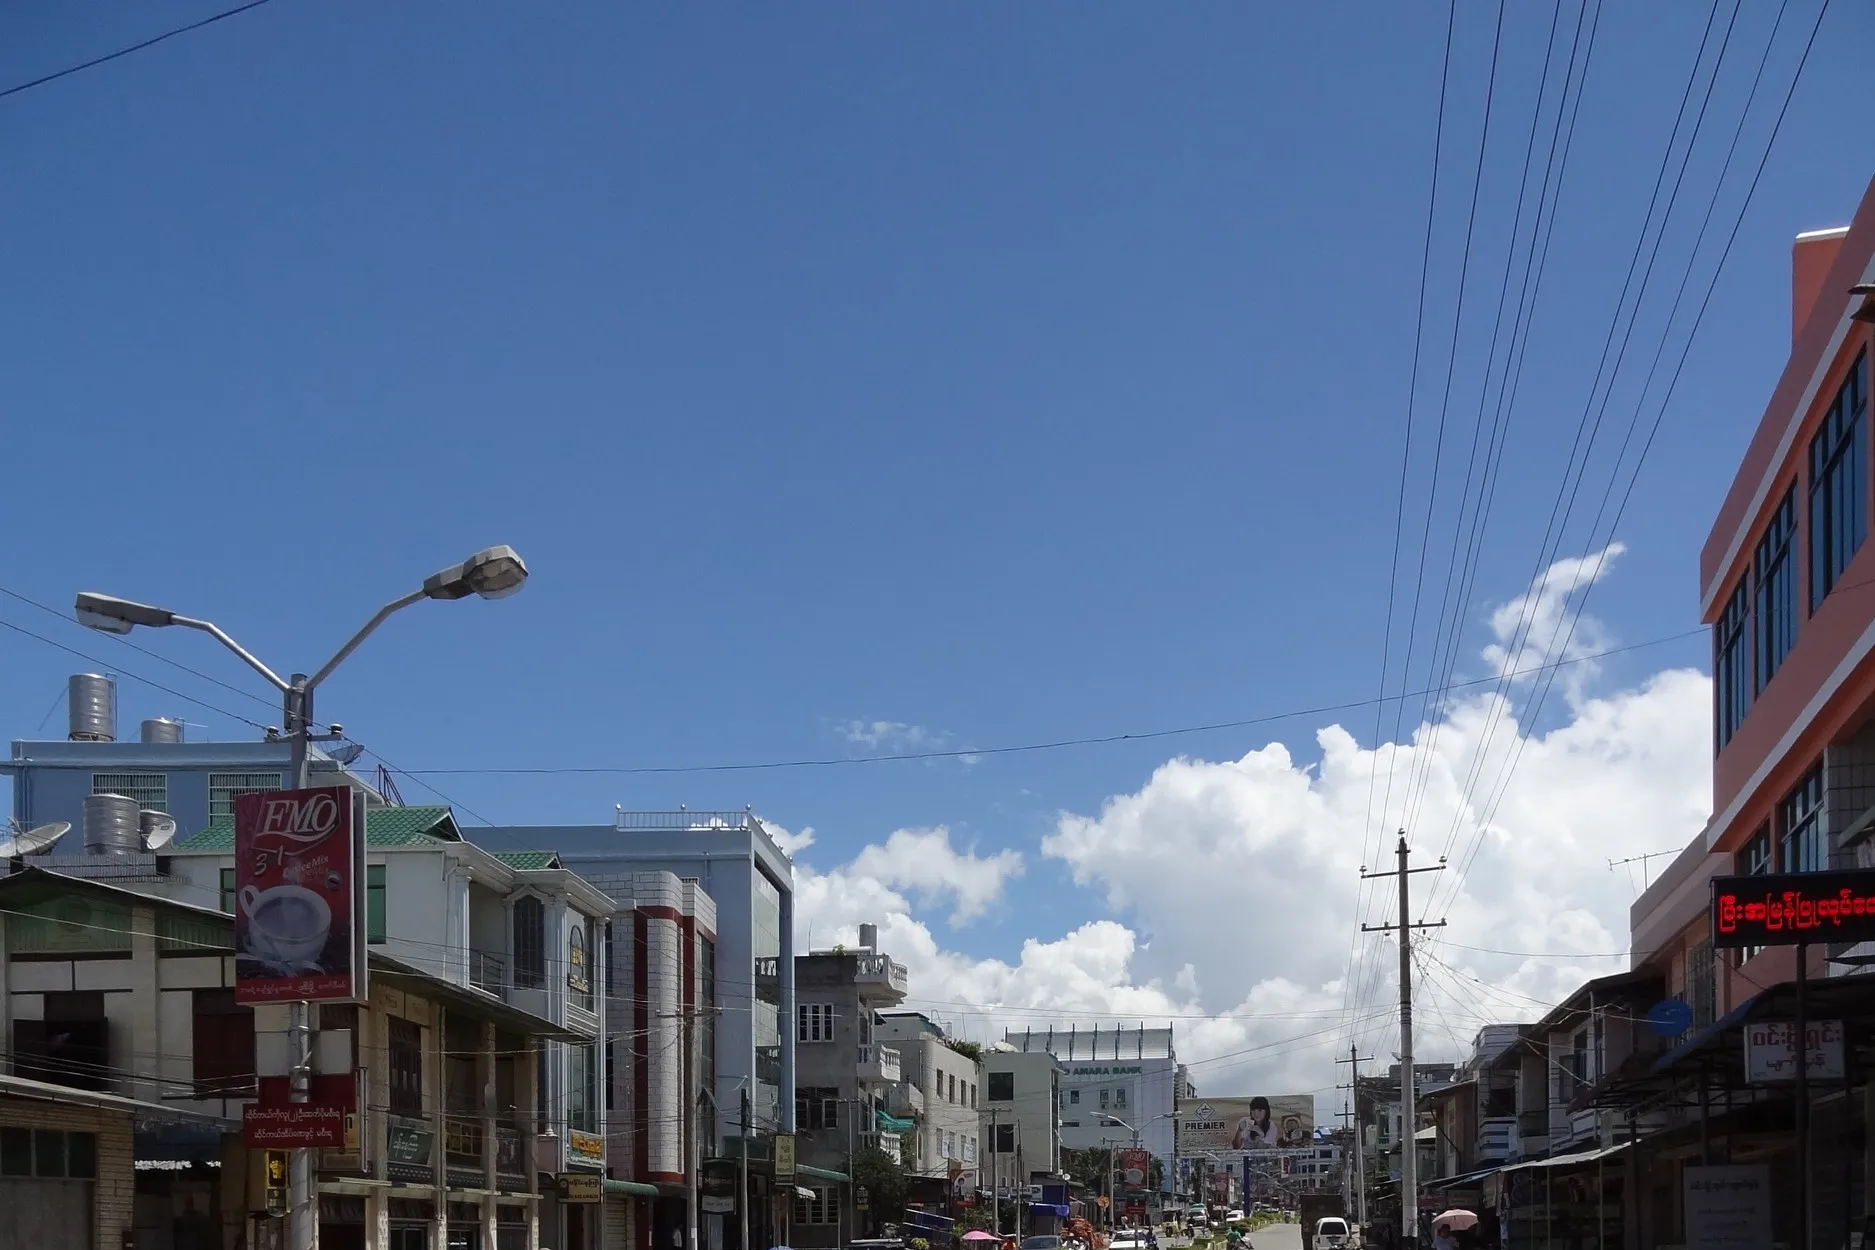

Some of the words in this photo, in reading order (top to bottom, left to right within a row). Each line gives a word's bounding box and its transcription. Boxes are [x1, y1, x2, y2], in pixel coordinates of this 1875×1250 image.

[254, 853, 267, 876] 3
[273, 845, 284, 866] 1
[1073, 1067, 1110, 1075] AMARA
[1112, 1066, 1143, 1075] BANK
[1184, 1120, 1226, 1131] PREMIER
